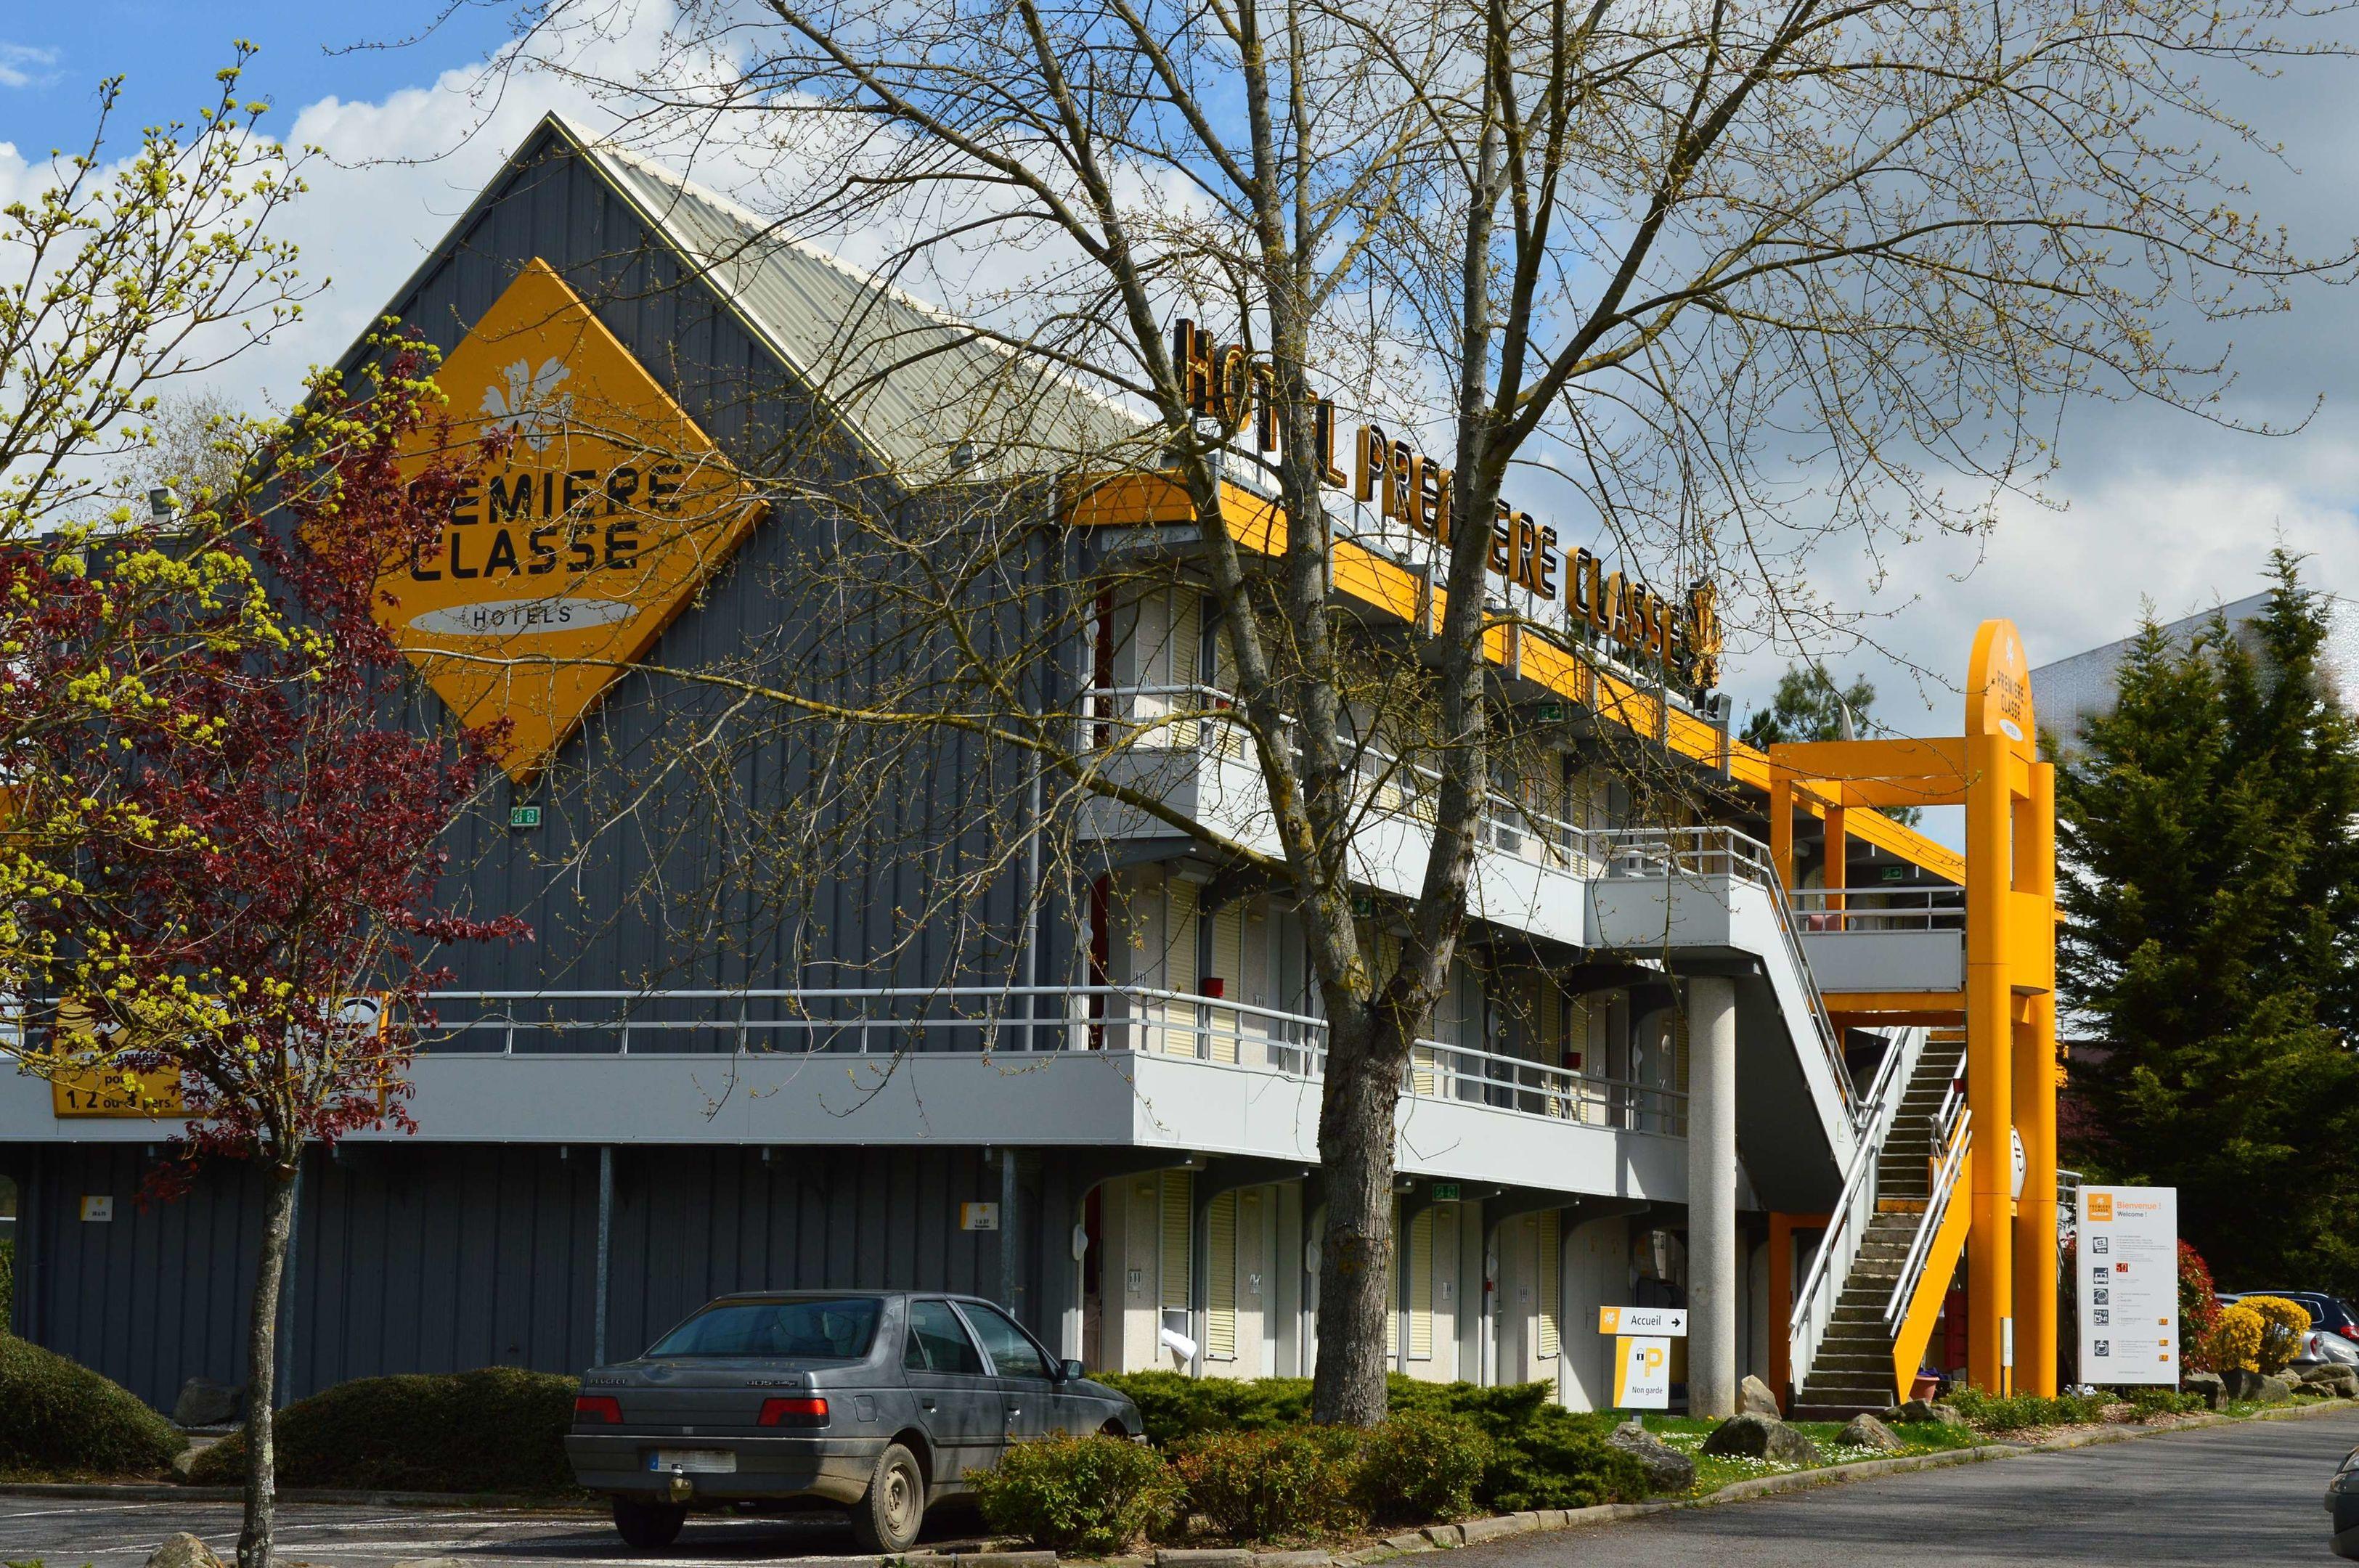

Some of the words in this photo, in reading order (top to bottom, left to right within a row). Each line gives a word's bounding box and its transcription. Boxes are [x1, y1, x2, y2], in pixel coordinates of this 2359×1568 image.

[407, 463, 683, 526] EMIERE
[1173, 317, 1348, 489] HOTL
[1355, 424, 1557, 601] PREERE
[1565, 546, 1683, 669] CLASSE
[409, 520, 640, 582] CLASSE
[472, 605, 572, 626] HOTELS
[1997, 669, 2024, 704] PREMIERE
[2000, 694, 2021, 722] CLASSE
[105, 1075, 128, 1087] pou
[65, 1090, 80, 1110] 1,
[85, 1090, 98, 1108] 2
[103, 1098, 120, 1108] ou
[125, 1091, 137, 1108] 3
[142, 1098, 175, 1113] pers.
[2116, 1201, 2157, 1210] Bienvenue
[1631, 1315, 1661, 1326] Accueil
[1645, 1347, 1663, 1378] P
